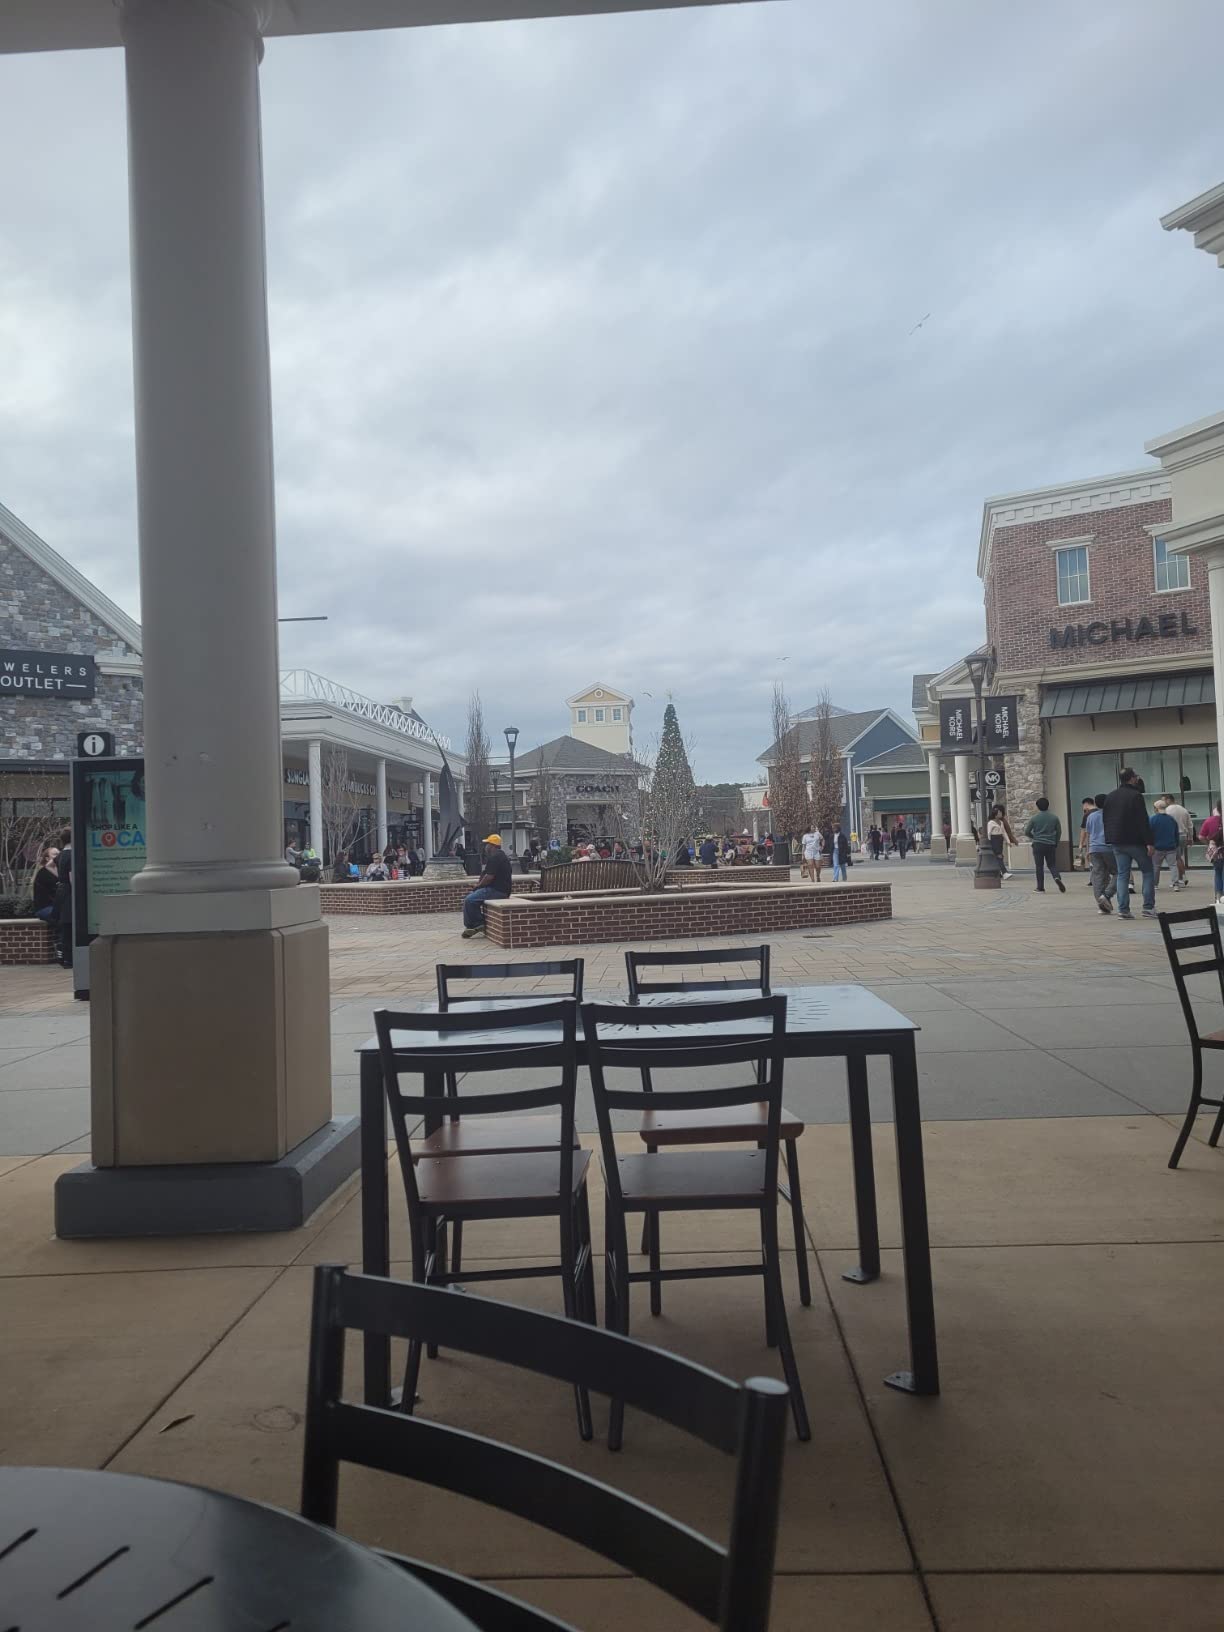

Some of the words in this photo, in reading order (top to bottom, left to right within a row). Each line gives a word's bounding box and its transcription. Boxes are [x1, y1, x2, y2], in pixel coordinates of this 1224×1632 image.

[1050, 611, 1198, 649] MICHAEL
[0, 675, 64, 690] OUTLET
[948, 716, 956, 737] KORS
[956, 709, 964, 741] MICHAEL
[994, 713, 1002, 734] KORS
[1001, 706, 1009, 738] MICHAEL
